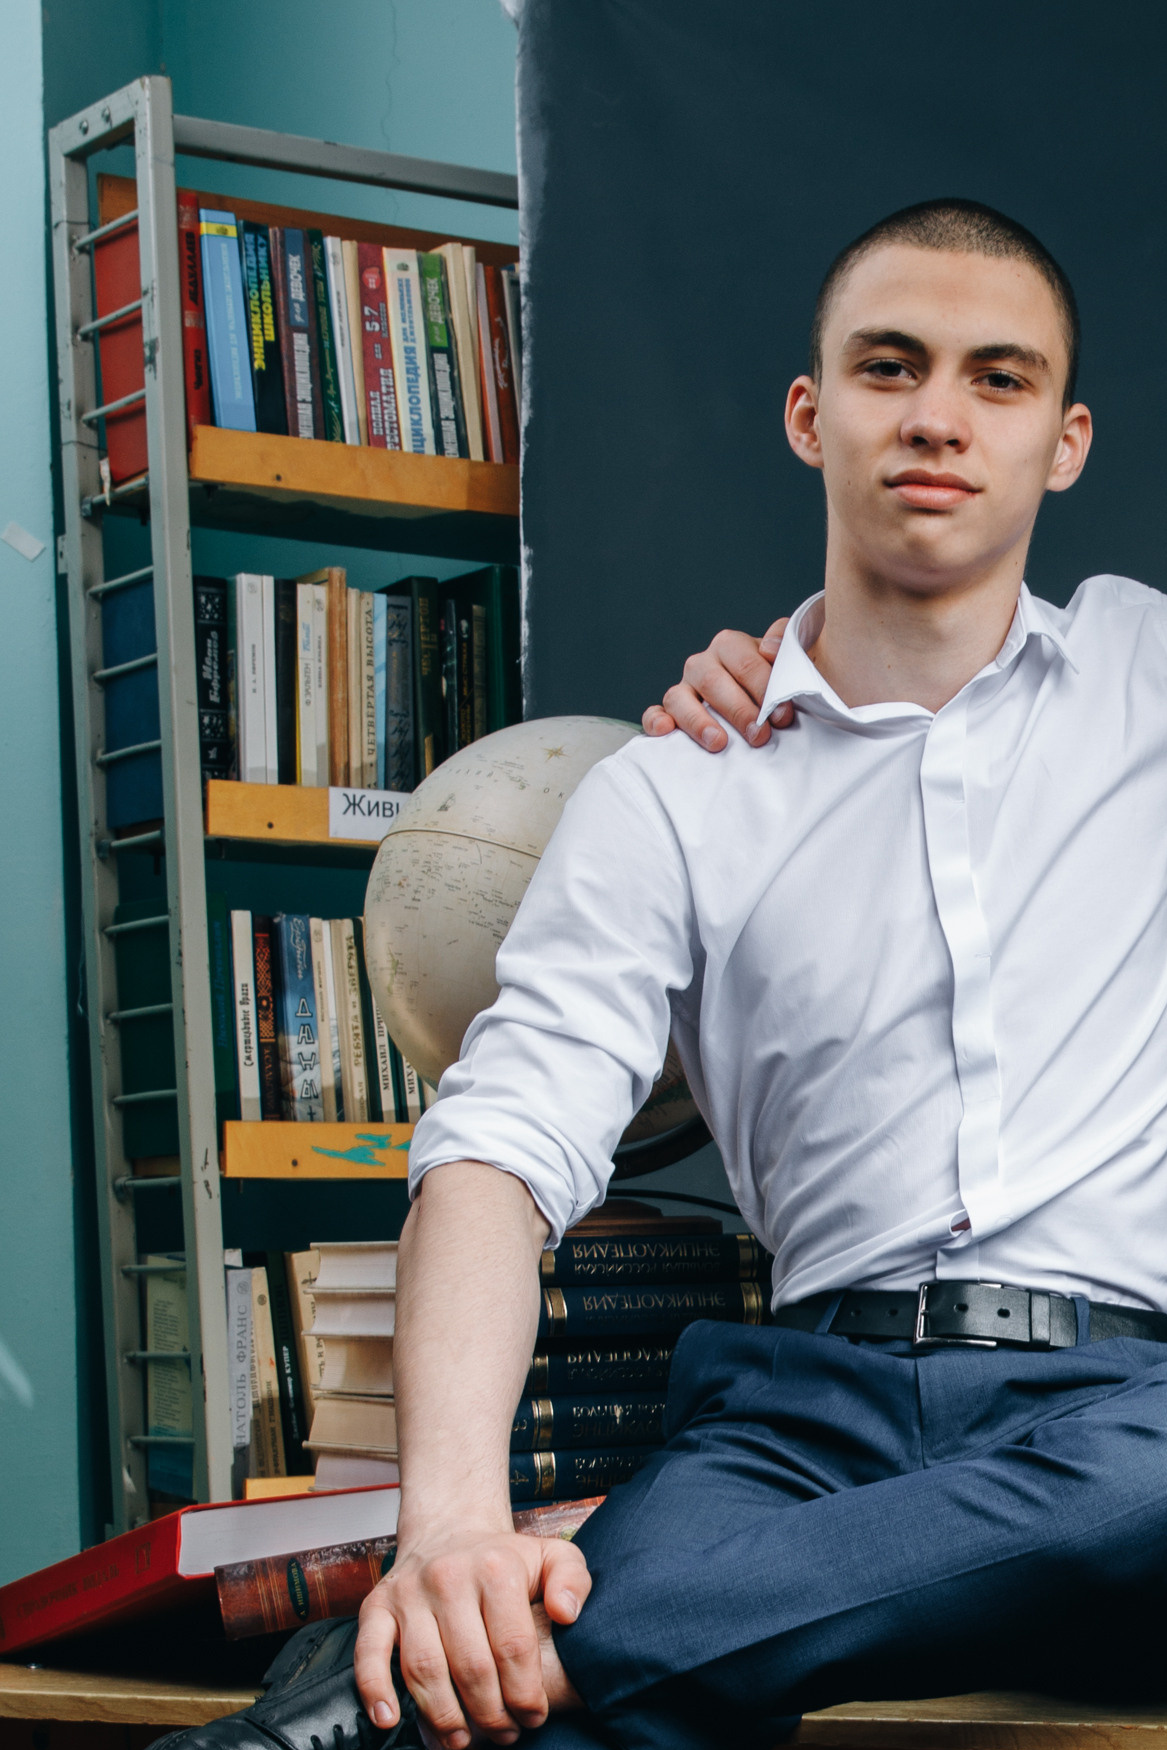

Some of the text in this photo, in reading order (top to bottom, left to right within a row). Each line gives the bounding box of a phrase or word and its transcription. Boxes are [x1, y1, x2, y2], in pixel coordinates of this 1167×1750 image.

[258, 235, 275, 341] ШКОЛЬНИКУ
[288, 253, 305, 302] ДЕВОЧЕК
[244, 233, 265, 370] ЭНЦИКЛОПЕДИЯ
[365, 609, 373, 666] ВЫСОТА
[380, 1044, 390, 1090] МИХАИЛ
[405, 1062, 416, 1094] МИХА
[571, 1240, 721, 1262] ЭНЦИКЛОПЕДИЯ
[581, 1290, 726, 1314] ЭНЦИКЛОПЕДИЯ
[235, 1305, 247, 1362] ФРАНС
[282, 1345, 292, 1373] КУПЕР
